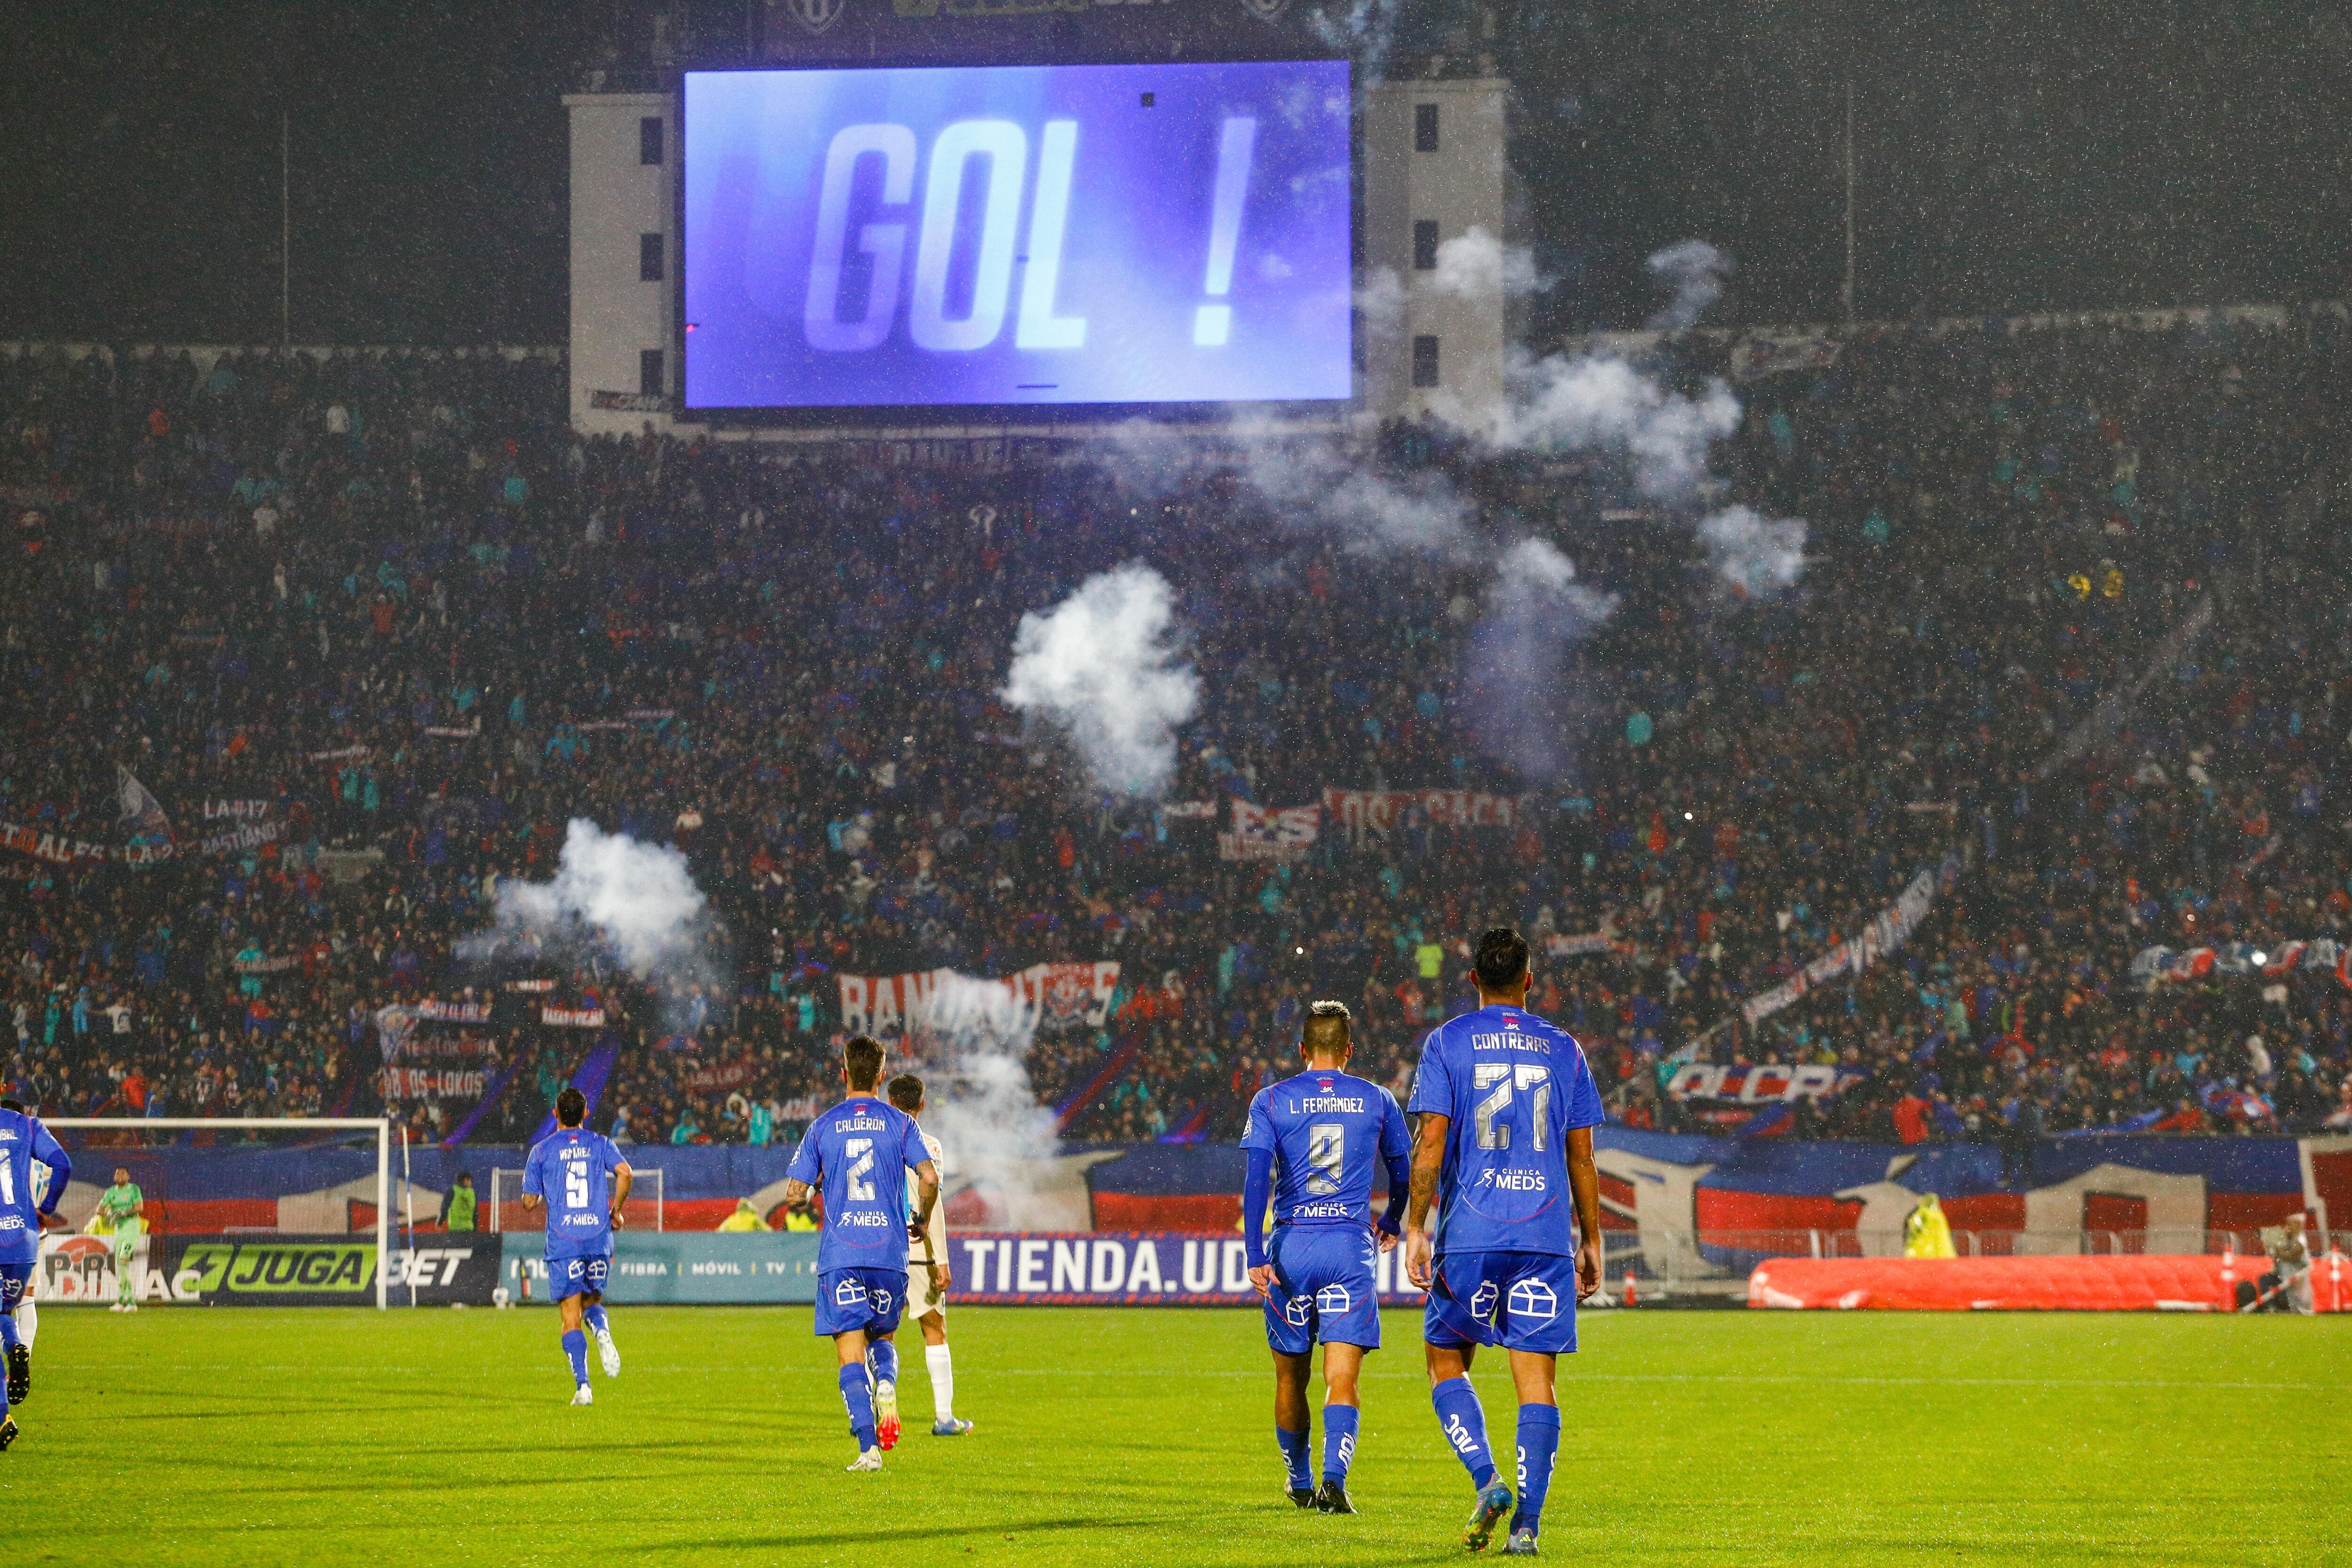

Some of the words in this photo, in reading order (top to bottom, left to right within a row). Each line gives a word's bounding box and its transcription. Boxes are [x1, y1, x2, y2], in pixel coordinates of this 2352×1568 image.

[804, 119, 1087, 354] GOL
[1472, 1032, 1550, 1055] CONTRERAS
[1290, 1099, 1300, 1114] L.
[1303, 1093, 1364, 1114] FERNÁNDEZ
[1473, 1063, 1550, 1152] 27
[835, 1116, 885, 1133] CALDERÓN
[846, 1138, 875, 1201] 2
[1306, 1123, 1344, 1195] 9
[566, 1161, 588, 1208] 5
[1496, 1174, 1546, 1191] MEDS
[573, 1216, 599, 1226] MEDS
[853, 1215, 888, 1227] MEDS
[1304, 1206, 1348, 1218] MEDS
[236, 1250, 363, 1285] JUGA
[375, 1248, 473, 1287] BET
[620, 1263, 668, 1276] FIBRA
[691, 1261, 741, 1275] MÓVIL
[766, 1263, 786, 1275] TV
